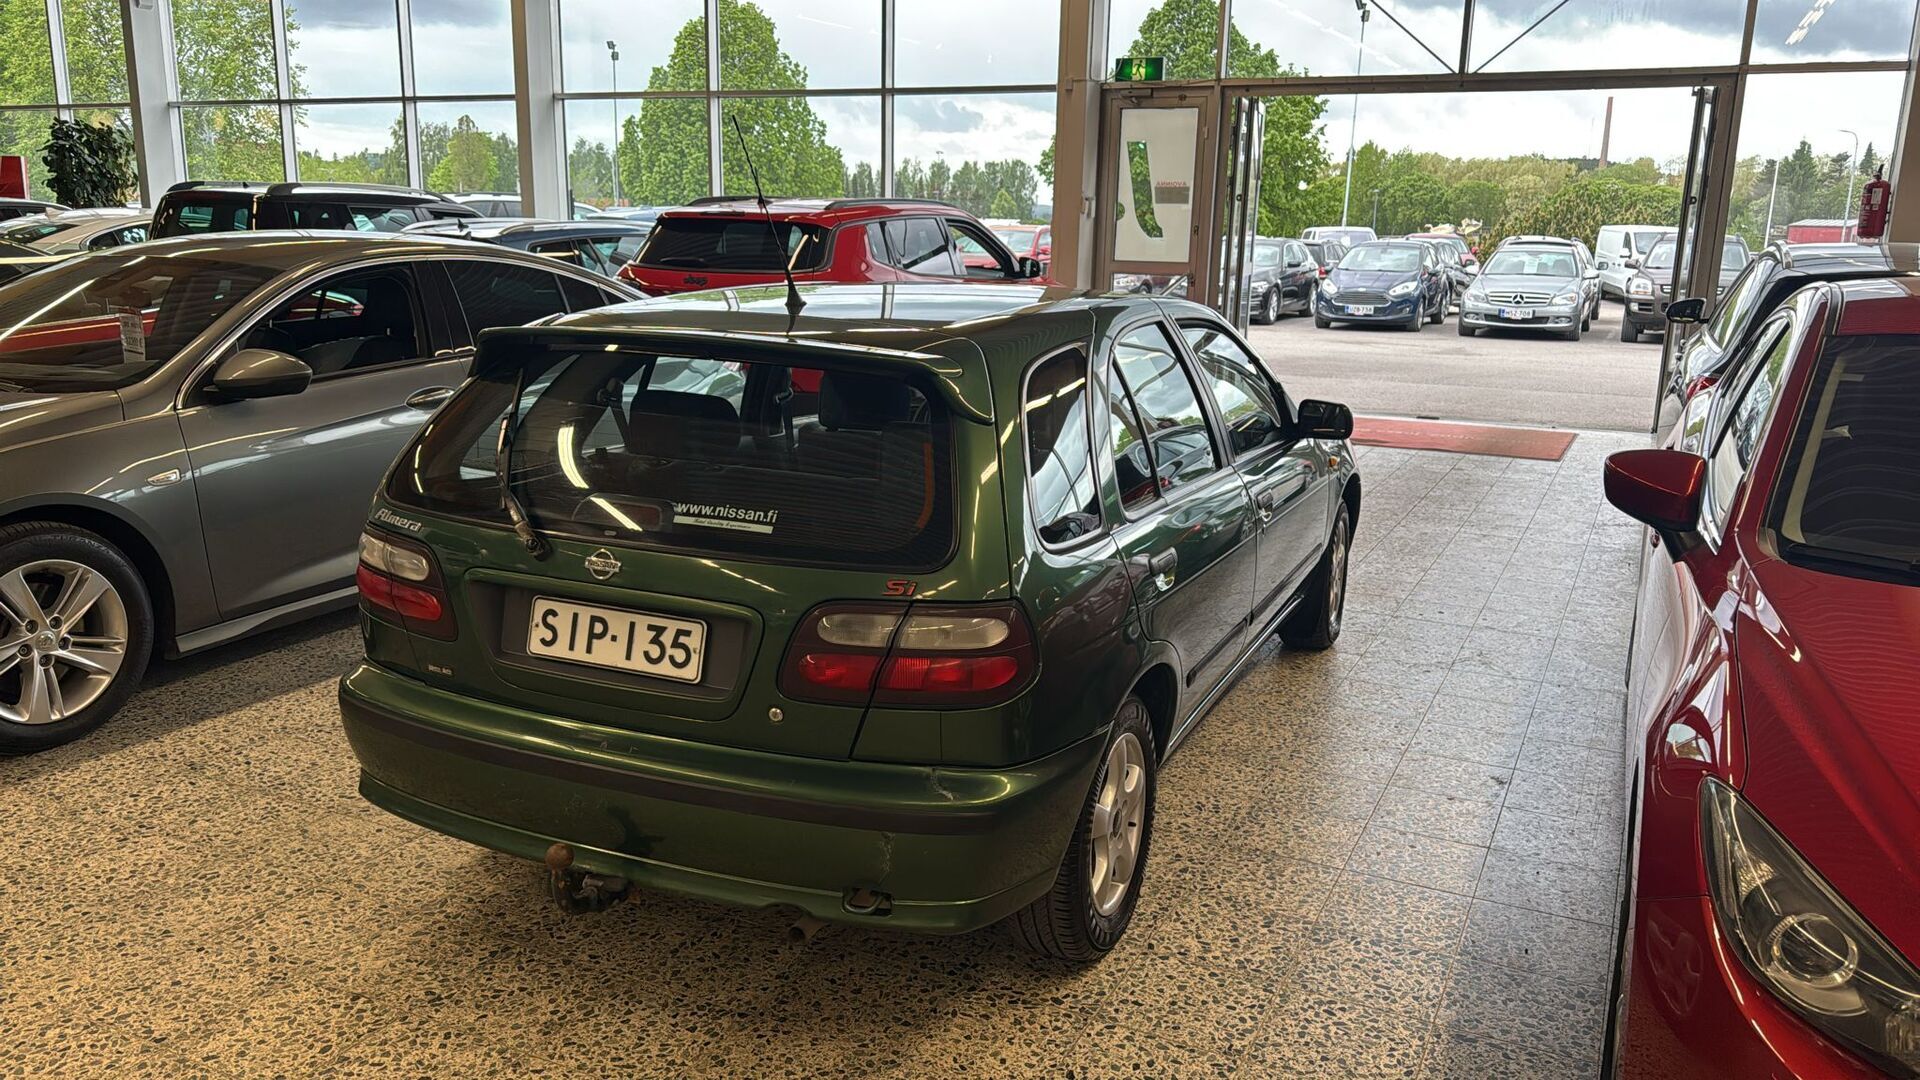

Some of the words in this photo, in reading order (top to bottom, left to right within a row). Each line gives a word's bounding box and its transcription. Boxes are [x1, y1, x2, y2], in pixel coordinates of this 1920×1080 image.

[374, 508, 421, 532] Almera
[675, 503, 779, 523] www.nissan.fi
[588, 558, 619, 571] NISSAN
